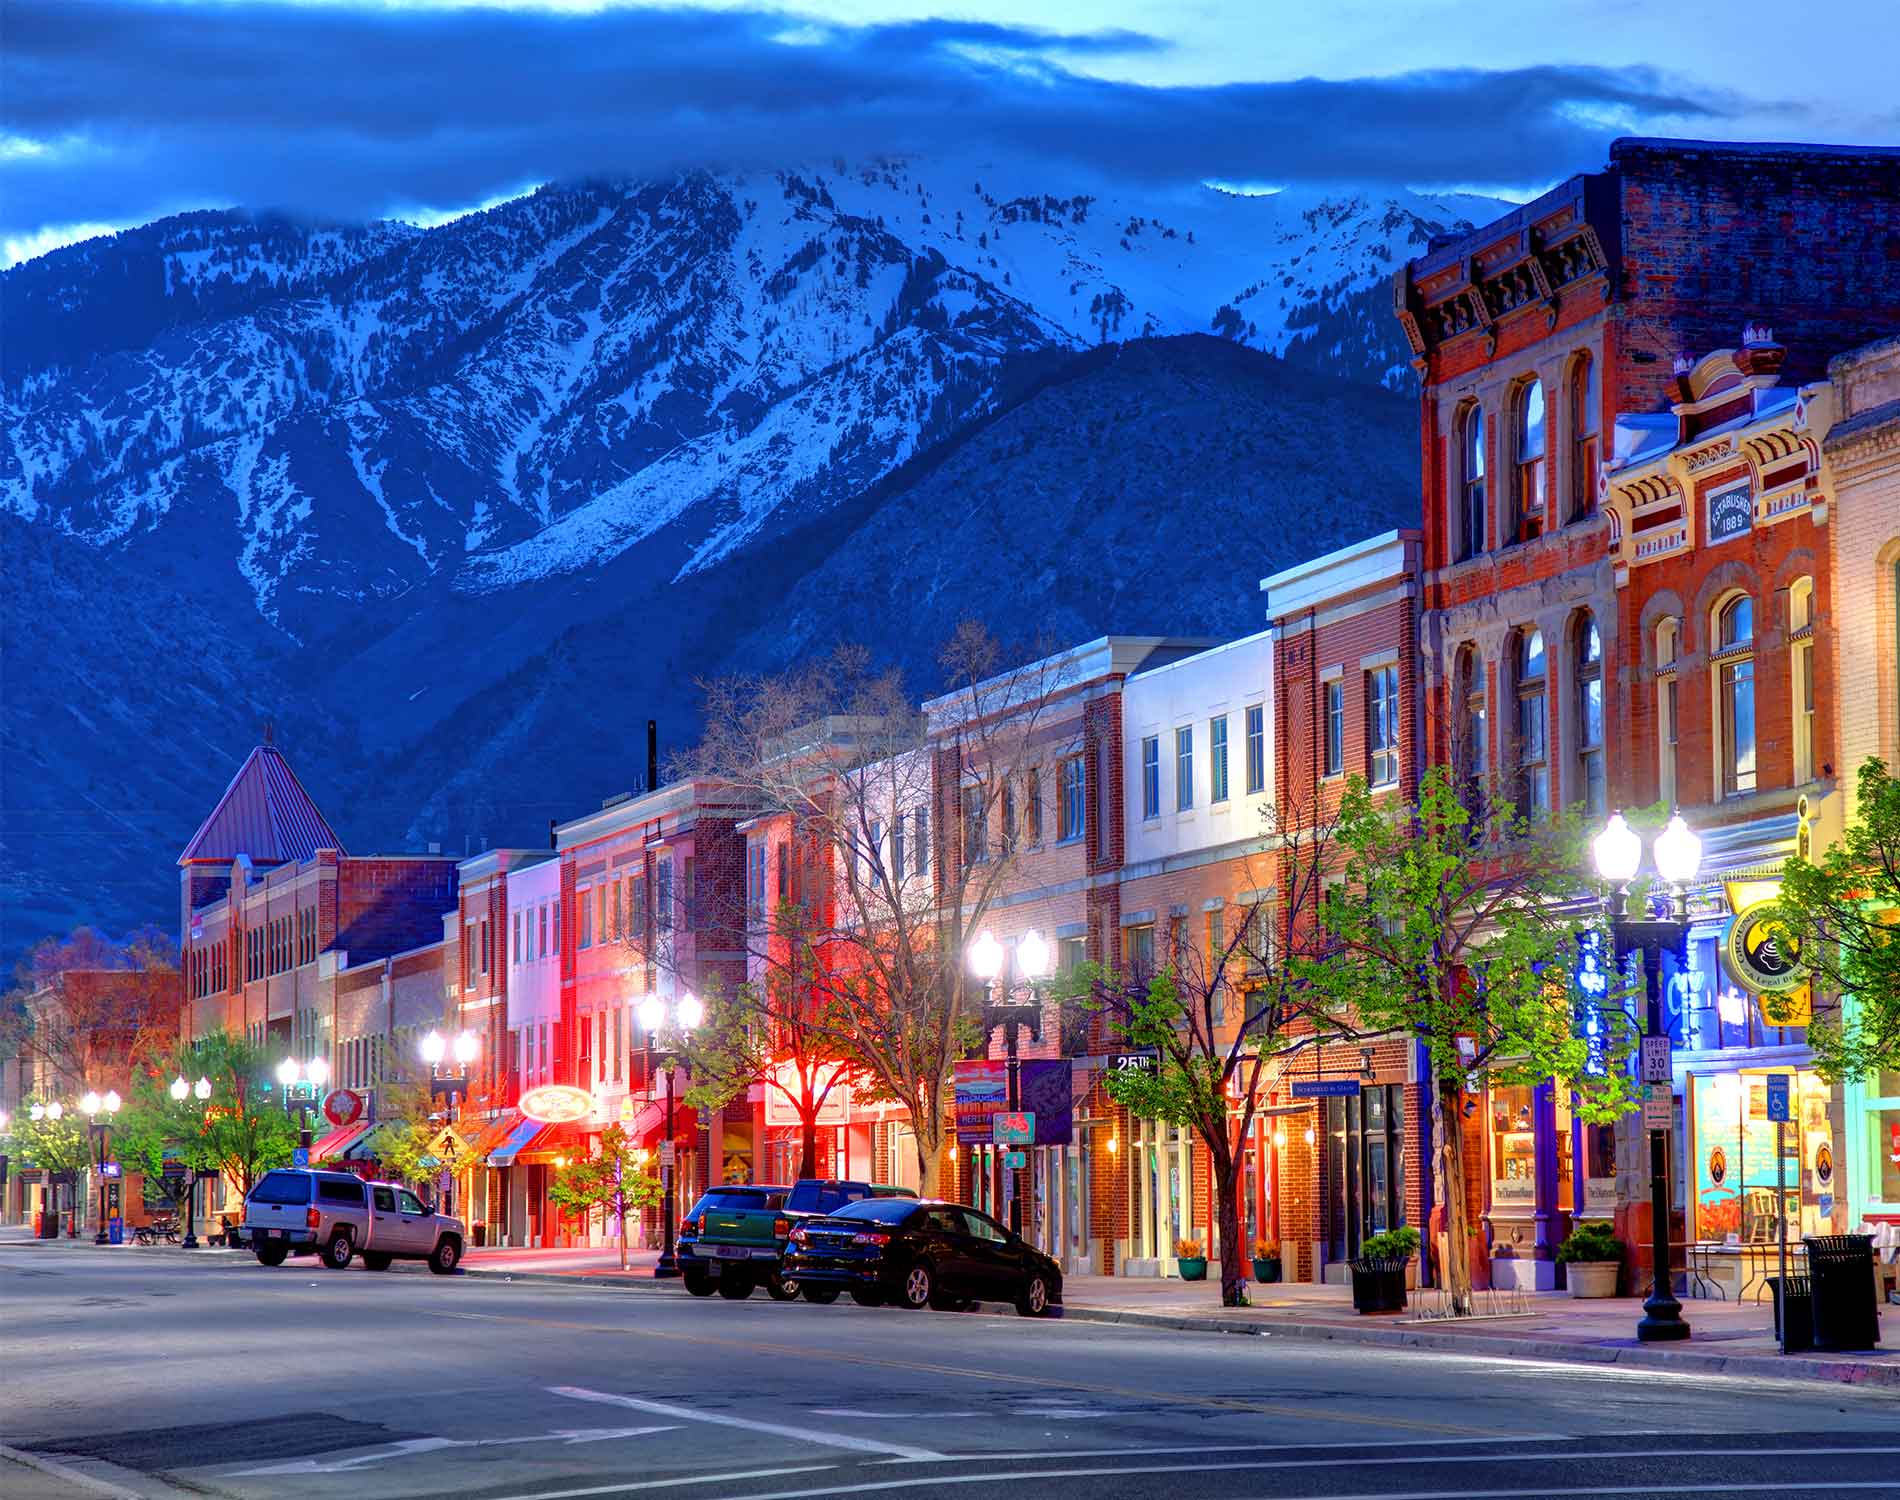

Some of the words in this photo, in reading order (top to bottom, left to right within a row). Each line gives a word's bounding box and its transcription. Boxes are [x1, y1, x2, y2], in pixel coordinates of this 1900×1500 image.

[1711, 495, 1751, 527] ESTABLISHED
[1722, 514, 1743, 533] 1889
[1735, 910, 1759, 964] GROUND
[1645, 1040, 1668, 1048] SPEED
[1647, 1049, 1667, 1057] LIMIT
[1117, 1056, 1150, 1072] 25TH
[1650, 1058, 1665, 1069] 30
[961, 1114, 992, 1124] HERITA
